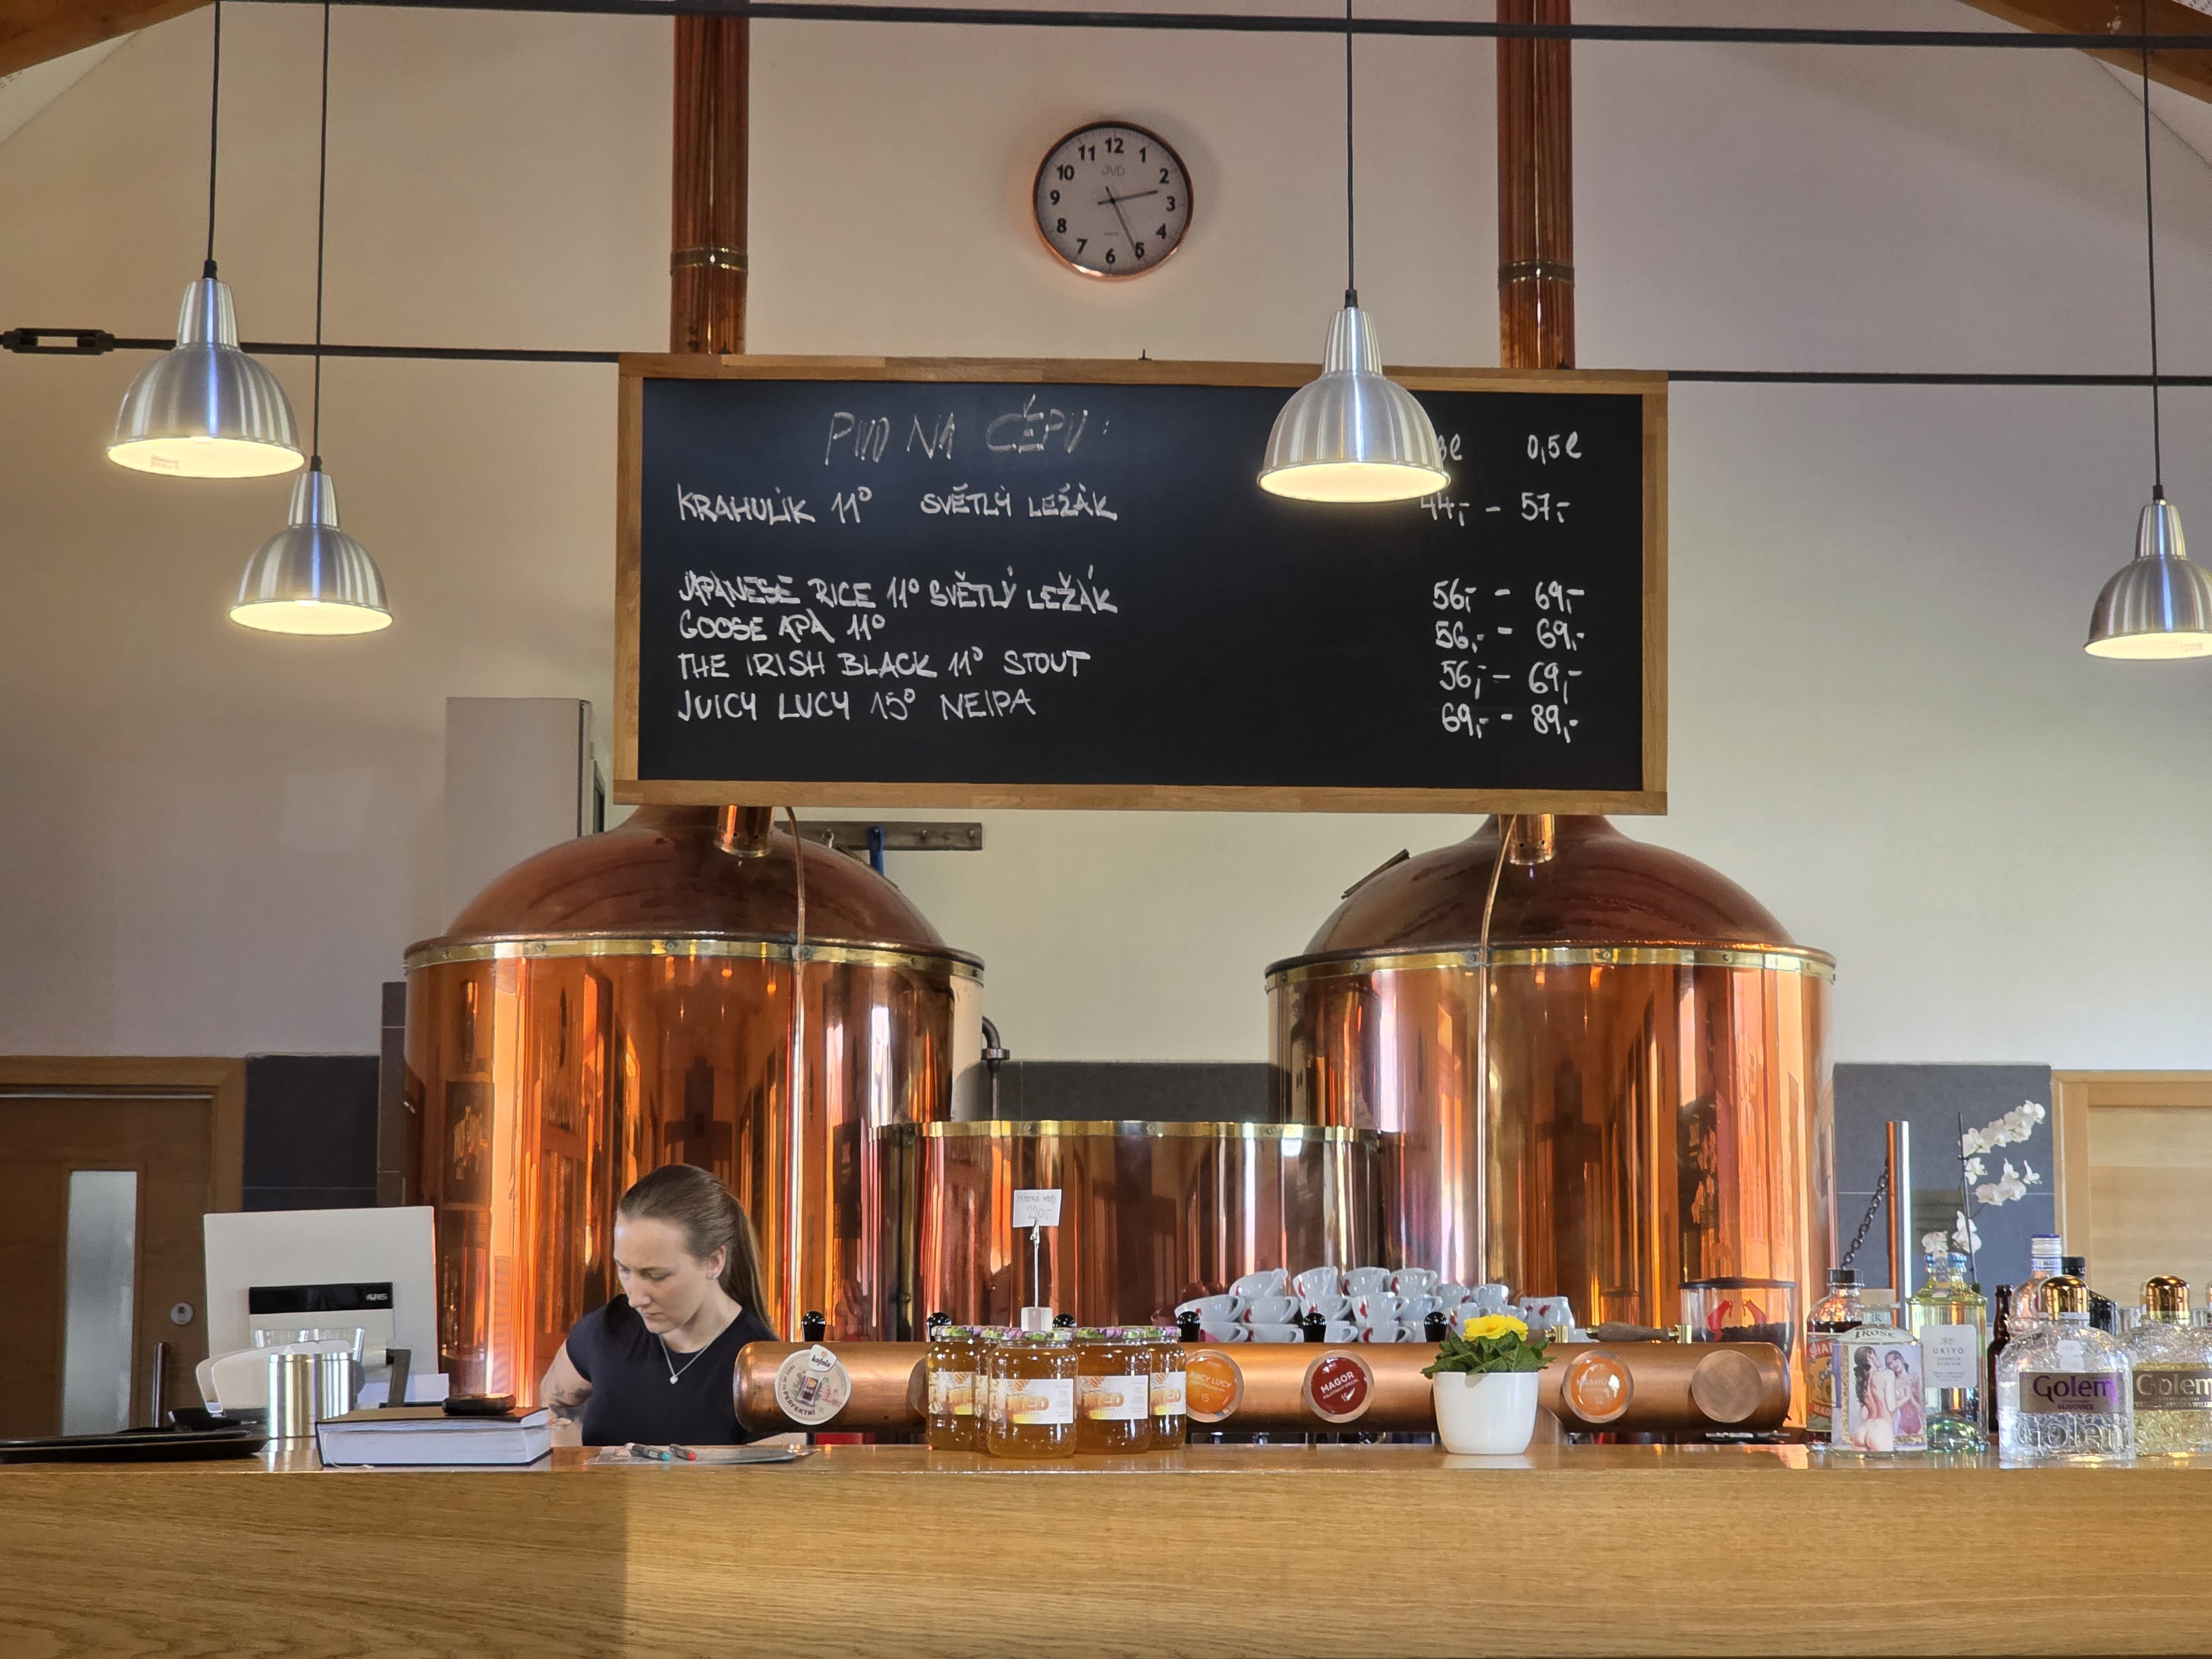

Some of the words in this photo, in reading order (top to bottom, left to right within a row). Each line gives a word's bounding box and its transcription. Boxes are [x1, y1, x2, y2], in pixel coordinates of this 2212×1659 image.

[1078, 145, 1095, 161] 11
[1105, 138, 1124, 154] 12
[1139, 147, 1146, 162] 1
[1056, 164, 1074, 180] 10
[1159, 168, 1170, 184] 2
[1050, 189, 1061, 205] 9
[1166, 196, 1176, 211] 3
[1056, 217, 1067, 233] 8
[1155, 223, 1167, 239] 4
[1076, 238, 1088, 254] 7
[1134, 242, 1145, 259] 5
[1105, 248, 1116, 264] 6
[906, 412, 956, 460] NA
[677, 483, 816, 525] KRAHULÍK
[920, 482, 1011, 517] SVĚTLÝ
[1027, 482, 1118, 521] LEŽÁK
[679, 570, 801, 608] JAPANESE
[807, 578, 877, 608] RICE
[929, 565, 1018, 609] SVĚTLÝ
[1026, 564, 1118, 614] LEŽÁK
[679, 608, 768, 642] GOOSE
[778, 608, 836, 644] APA
[677, 653, 730, 680] THE
[746, 649, 826, 678] IRISH
[837, 650, 938, 679] BLACK
[1003, 649, 1091, 678] STOUT
[678, 689, 757, 721] JUICY
[778, 691, 851, 721] LUCY
[940, 688, 1036, 721] NEIPA
[811, 1355, 831, 1368] kofola
[1188, 1371, 1211, 1383] JUICY
[1211, 1378, 1233, 1389] LUCY
[1320, 1371, 1355, 1394] MAGOR
[2136, 1374, 2212, 1400] Golem
[948, 1389, 973, 1404] ME
[1150, 1387, 1182, 1404] MED
[1201, 1392, 1210, 1403] 15
[2032, 1375, 2117, 1405] Golem
[1006, 1396, 1050, 1412] MED
[1083, 1392, 1124, 1407] MED
